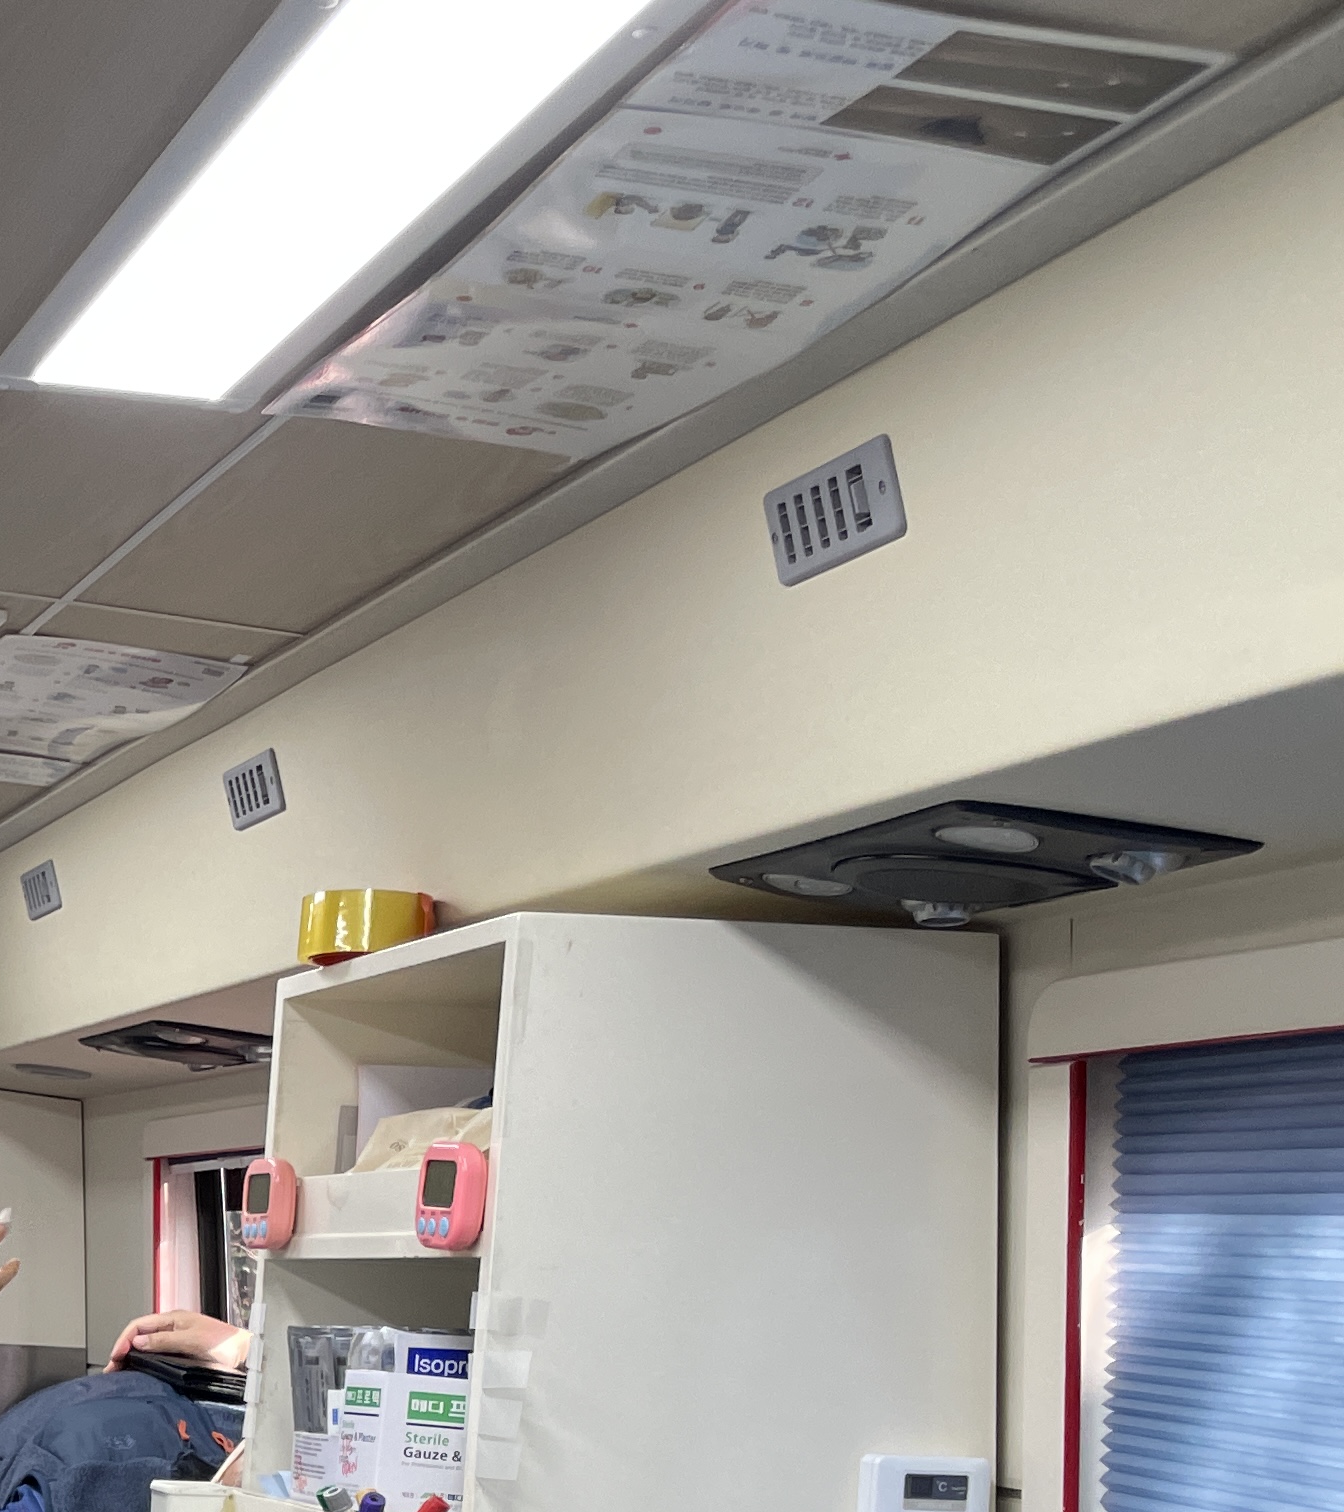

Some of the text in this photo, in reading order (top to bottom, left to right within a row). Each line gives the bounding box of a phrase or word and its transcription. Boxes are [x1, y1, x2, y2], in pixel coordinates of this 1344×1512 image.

[414, 1353, 468, 1377] Isopr
[404, 1431, 450, 1447] Sterile
[403, 1446, 462, 1463] Gauze &
